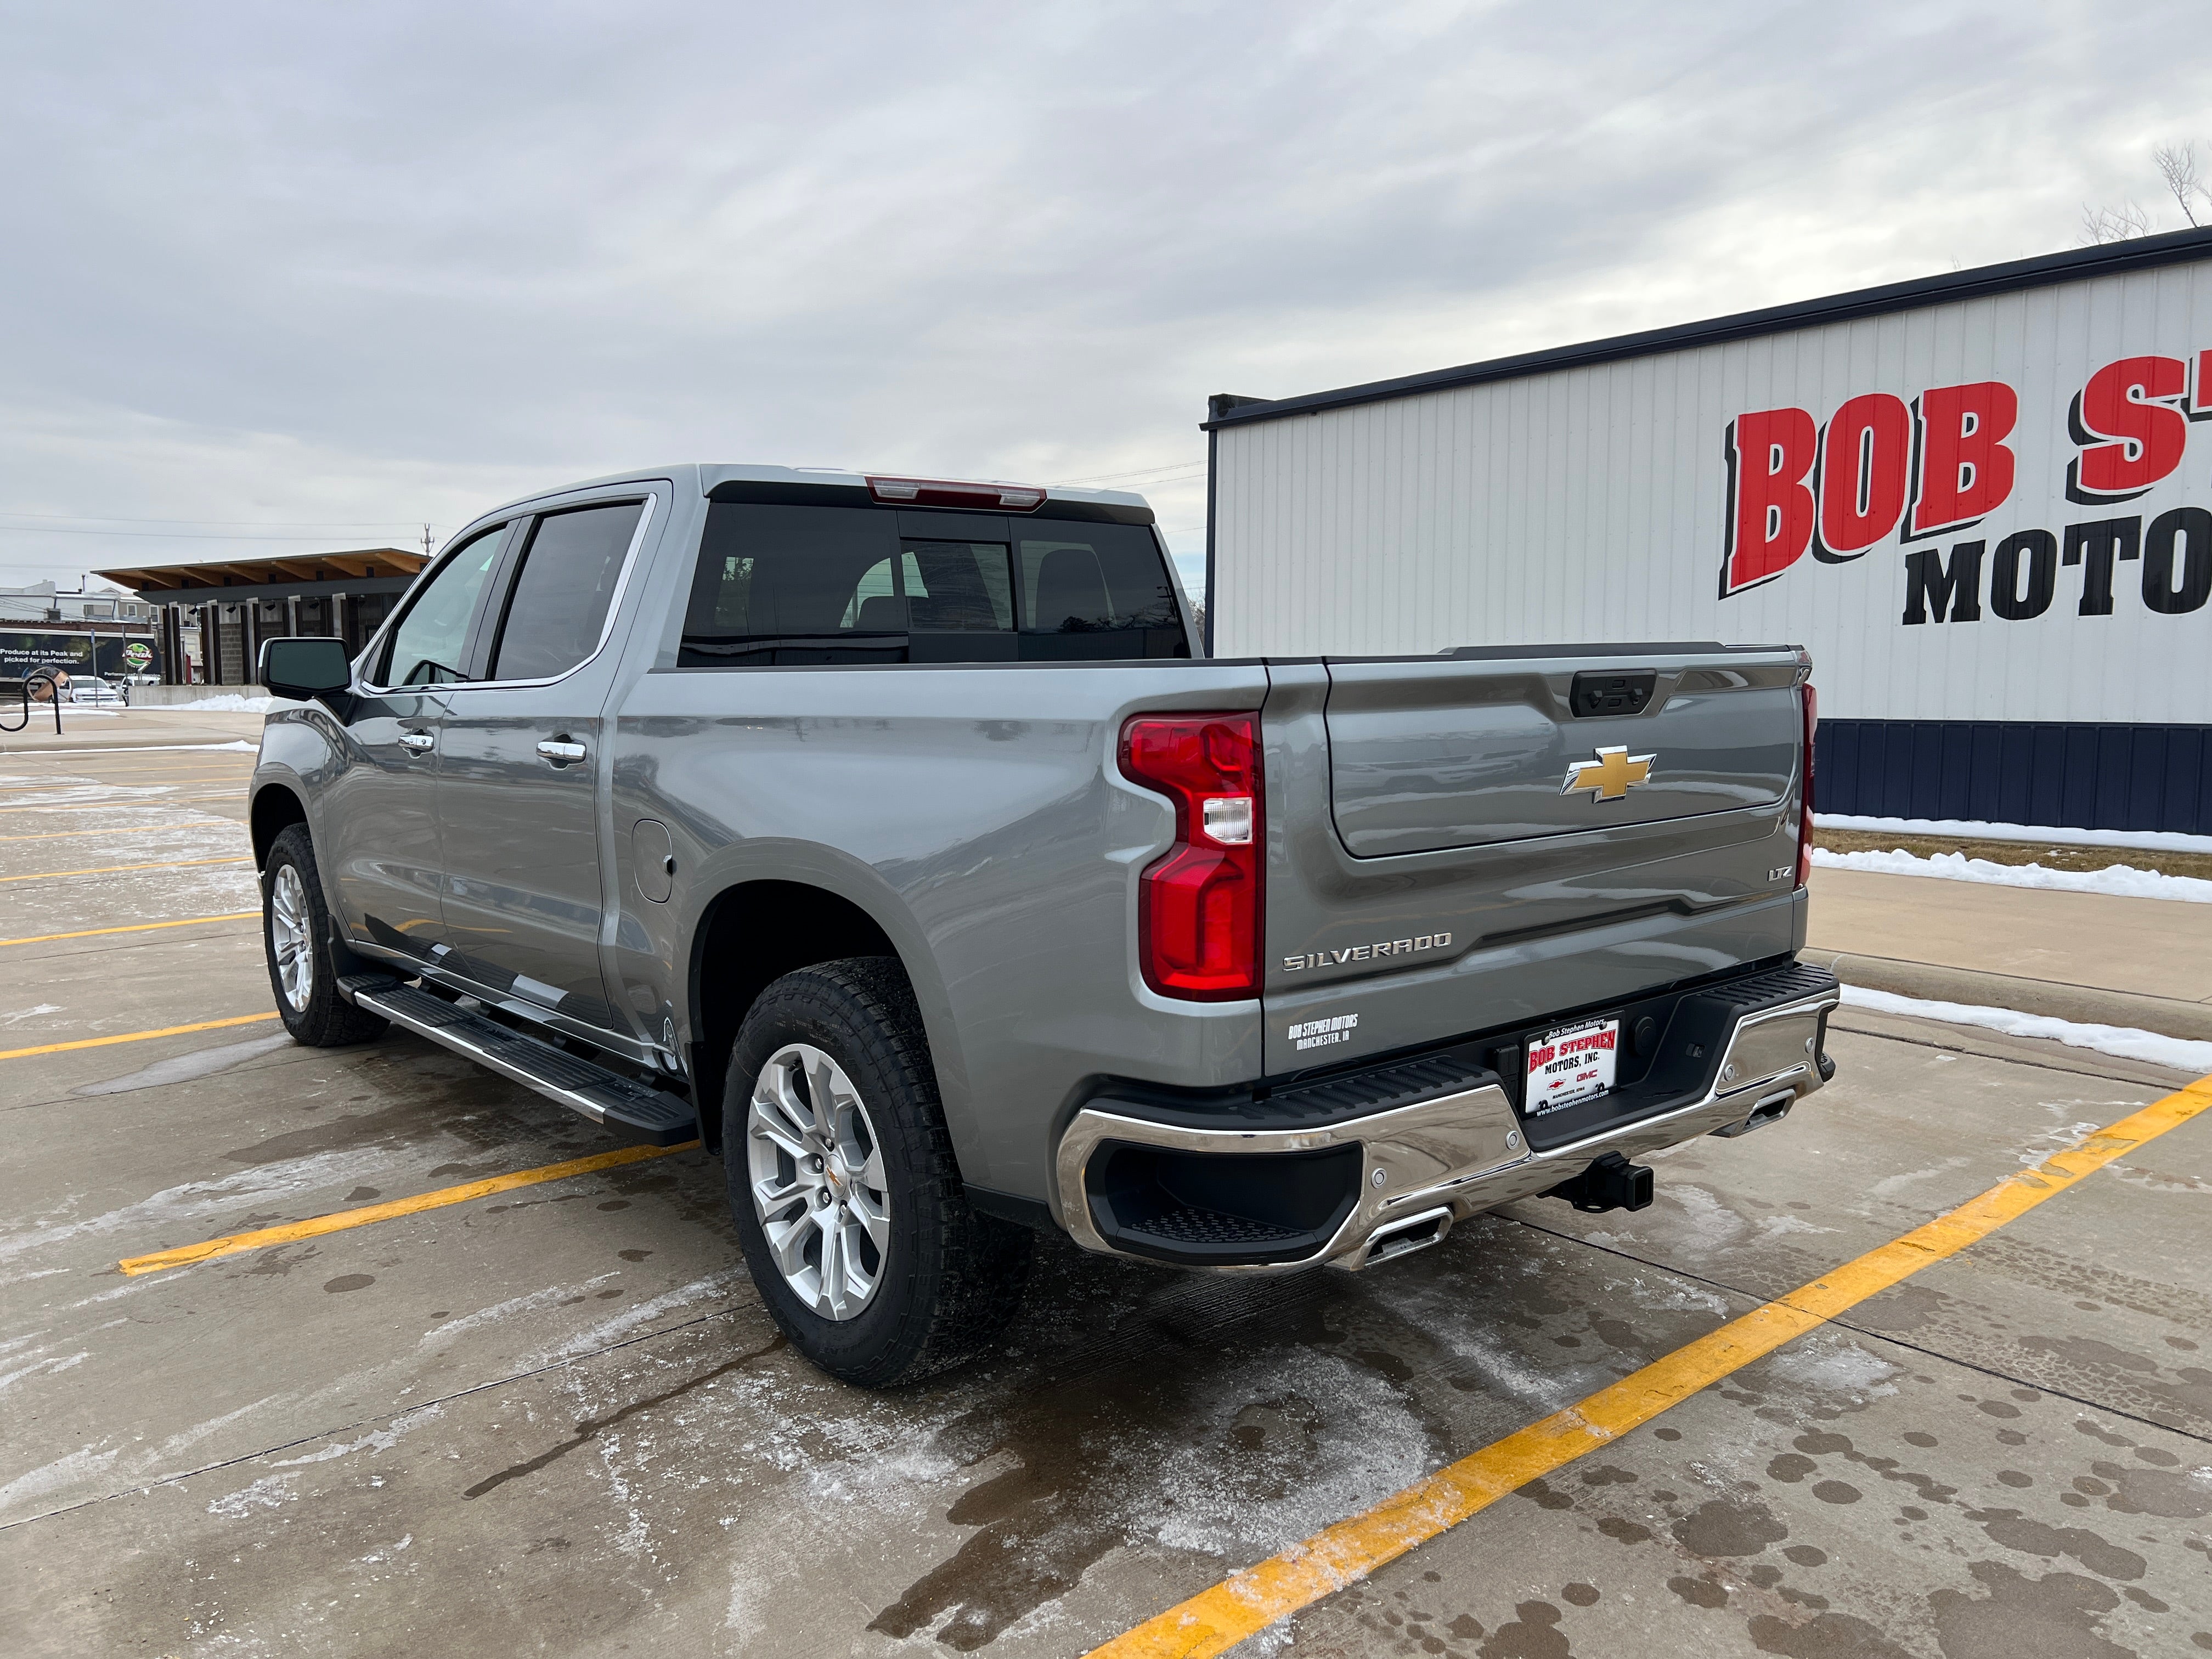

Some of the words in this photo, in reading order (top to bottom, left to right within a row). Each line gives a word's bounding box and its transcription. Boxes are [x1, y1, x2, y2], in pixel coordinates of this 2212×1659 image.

[1719, 381, 2018, 600] BOB
[1768, 866, 1792, 881] LTZ
[1283, 932, 1452, 972] SILVERADO
[1288, 1025, 1302, 1040] BOB
[1302, 1018, 1331, 1037] STEPHEN
[1331, 1013, 1358, 1031] MOTORS
[1342, 1030, 1350, 1041] IA
[1549, 1030, 1560, 1039] Bob
[1560, 1024, 1584, 1036] Stephen
[1585, 1019, 1605, 1029] Motors
[1528, 1045, 1555, 1074] BOB
[1559, 1029, 1616, 1057] STEPHEN
[1545, 1056, 1582, 1075] MOTORS,
[1584, 1051, 1600, 1065] INC.
[1576, 1069, 1598, 1082] GMC
[1537, 1089, 1609, 1117] www.bobstephenmotors.com
